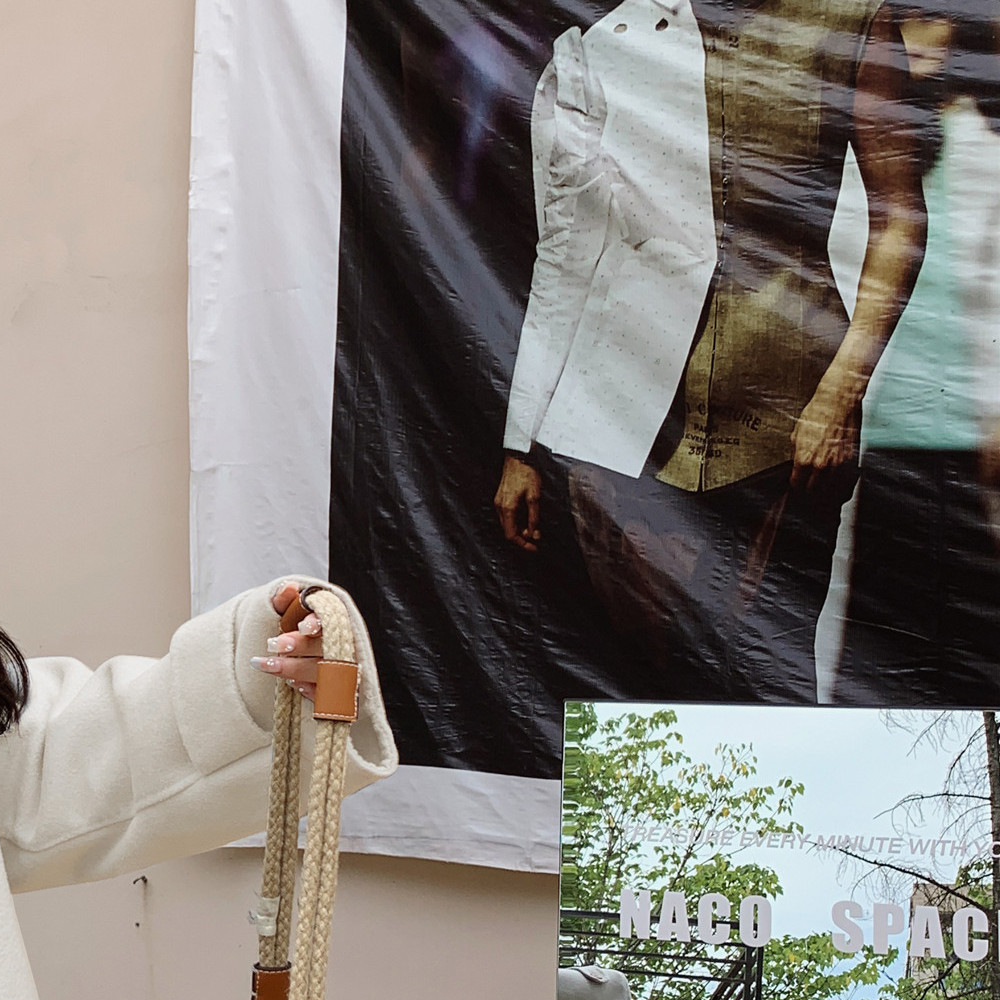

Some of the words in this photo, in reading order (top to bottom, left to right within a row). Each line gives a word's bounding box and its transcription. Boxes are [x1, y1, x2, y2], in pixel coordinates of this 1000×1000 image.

[622, 824, 735, 847] TREASURE
[739, 829, 812, 850] EVERY
[815, 834, 904, 855] MINUTE
[908, 838, 967, 857] WITH
[619, 889, 772, 948] NACO
[831, 900, 1000, 963] SPAC
